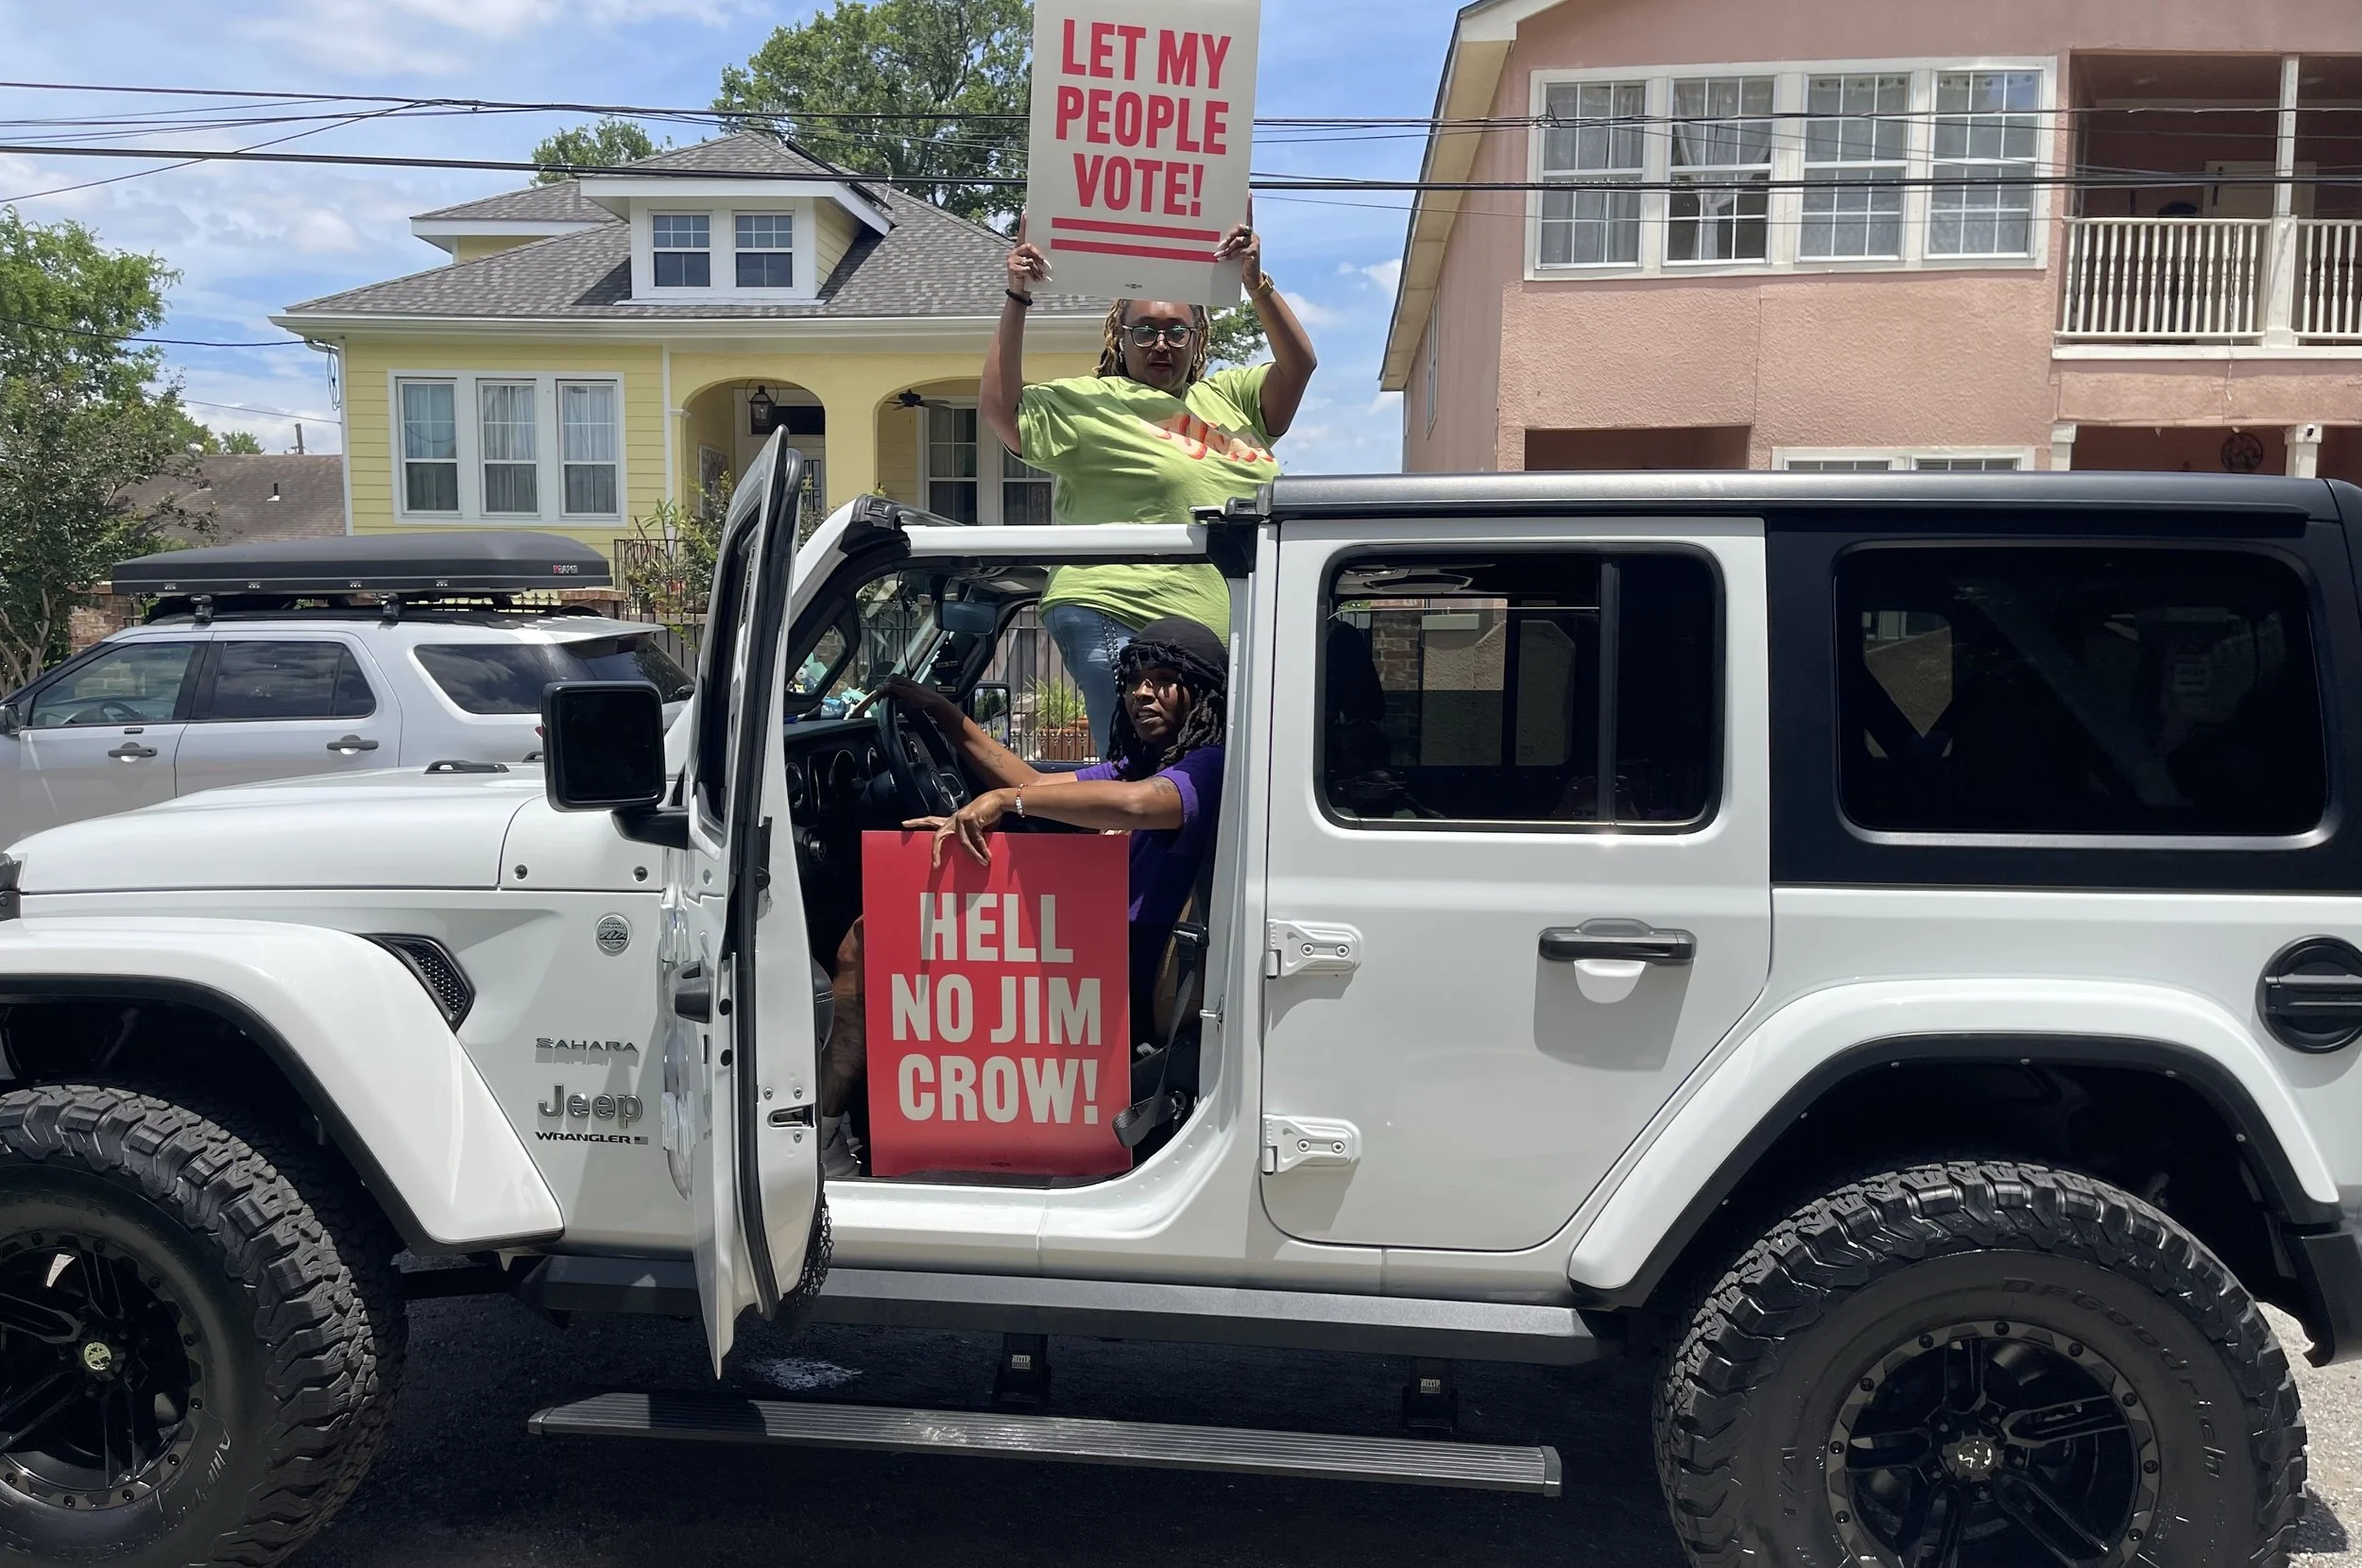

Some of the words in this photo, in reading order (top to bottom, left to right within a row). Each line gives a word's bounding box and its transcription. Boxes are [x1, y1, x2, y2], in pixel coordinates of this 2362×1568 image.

[1062, 19, 1146, 81] LET
[1157, 29, 1232, 89] MY
[1055, 85, 1229, 155] PEOPLE
[1073, 153, 1205, 217] VOTE!
[919, 892, 1073, 963] HELL
[535, 1037, 639, 1052] SAHARA
[891, 974, 974, 1043] NO
[990, 976, 1102, 1046] JIM
[538, 1083, 642, 1129] Jeep
[899, 1053, 1099, 1124] CROW!
[535, 1132, 631, 1144] WRANGLER
